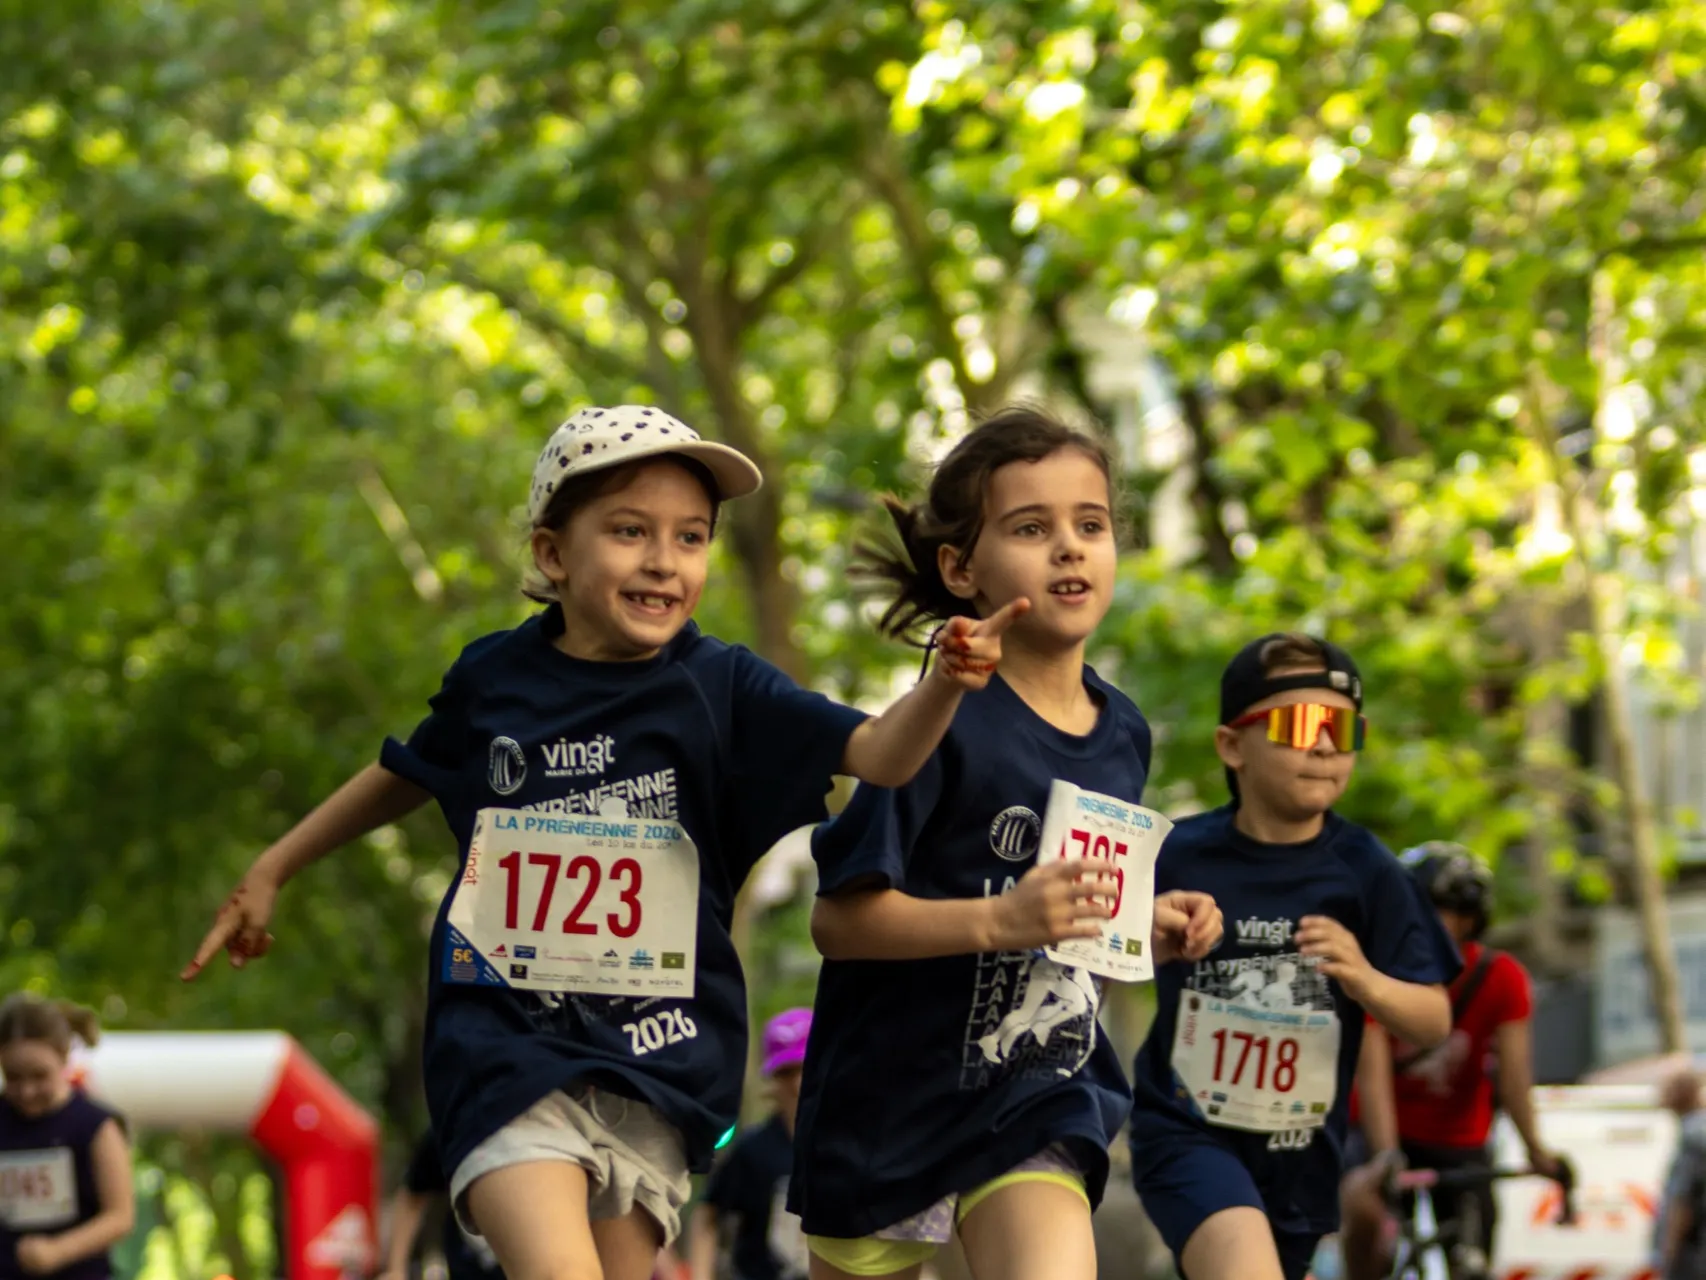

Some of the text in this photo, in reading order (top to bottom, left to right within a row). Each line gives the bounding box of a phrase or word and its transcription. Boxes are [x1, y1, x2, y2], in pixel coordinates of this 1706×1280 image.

[540, 733, 615, 774] vingt
[544, 768, 573, 777] MAIRIE
[495, 815, 519, 831] LA
[644, 825, 682, 841] 2026
[498, 851, 643, 939] 1723
[1236, 915, 1293, 945] vingt
[452, 948, 474, 964] 5€
[975, 967, 1008, 988] LA
[972, 986, 1004, 1007] LA
[623, 1007, 698, 1056] 2026
[1211, 1027, 1299, 1092] 1718
